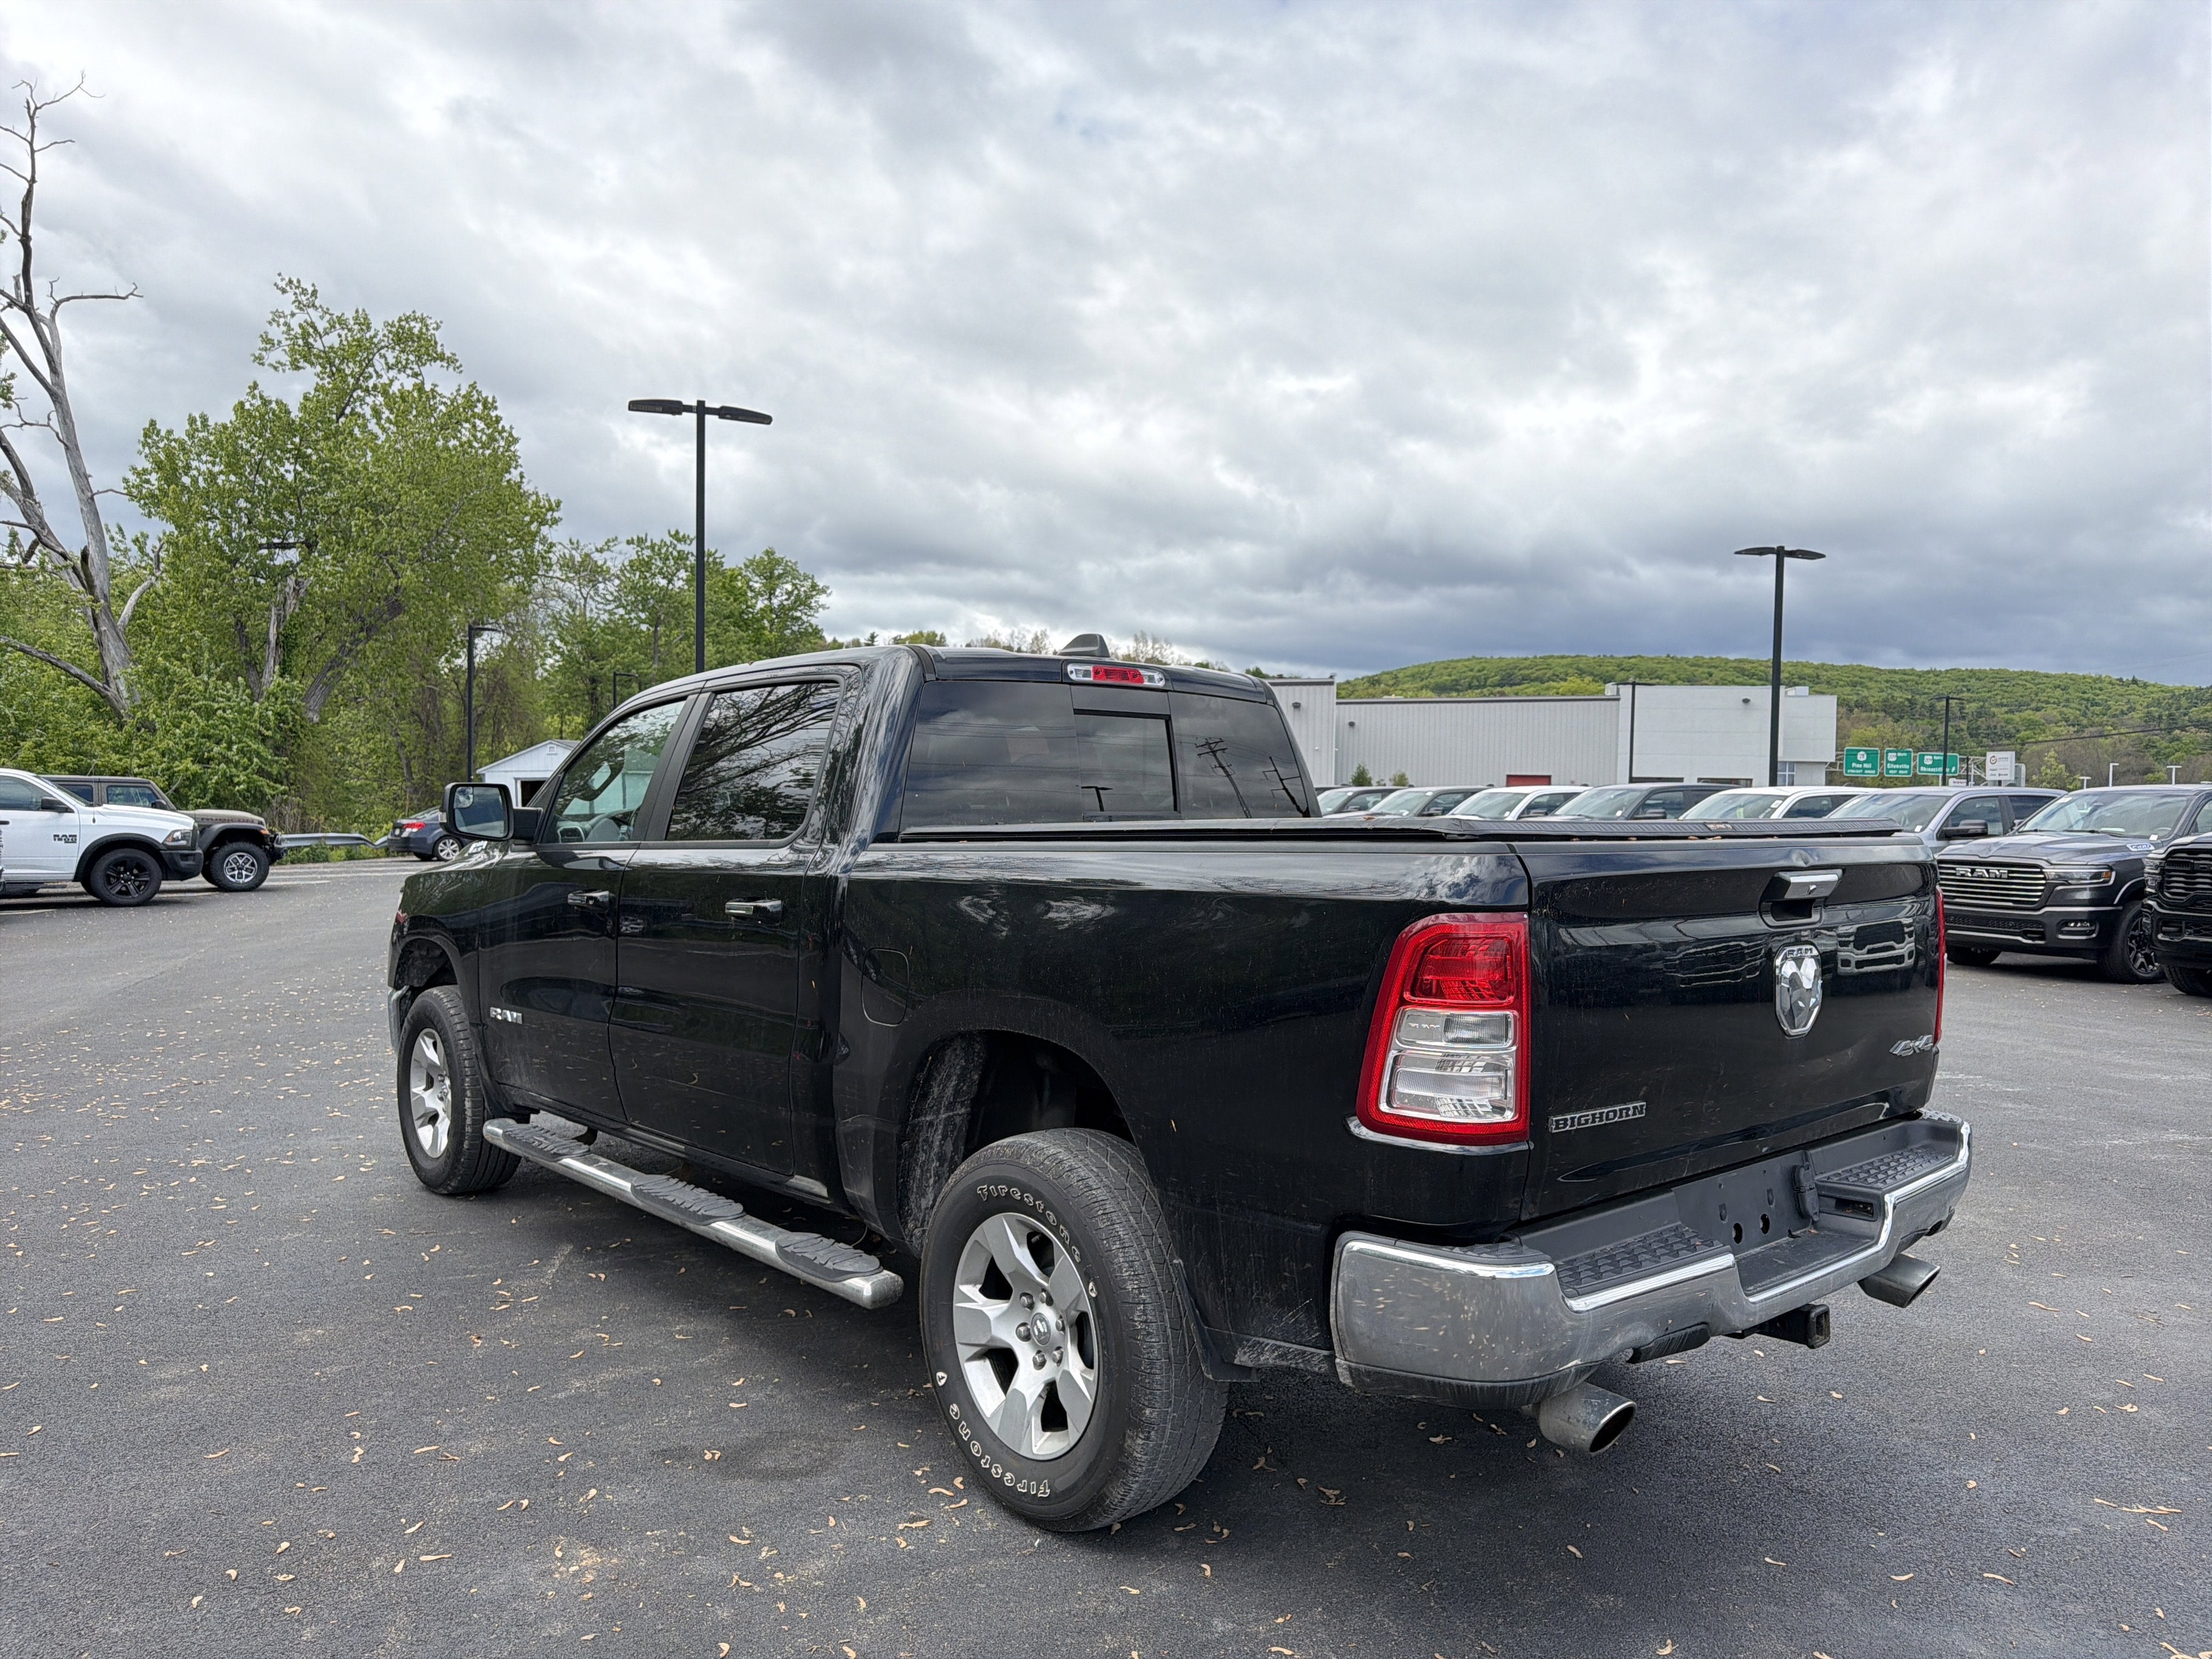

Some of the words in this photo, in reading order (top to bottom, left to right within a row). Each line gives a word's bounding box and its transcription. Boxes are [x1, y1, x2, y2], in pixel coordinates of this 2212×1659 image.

[1956, 867, 2008, 878] RAM
[1787, 947, 1813, 956] RAM
[490, 1007, 523, 1024] RAM
[1552, 1103, 1646, 1133] BIGHORN
[977, 1184, 1081, 1263] Firestone
[949, 1403, 1051, 1498] Firestone
